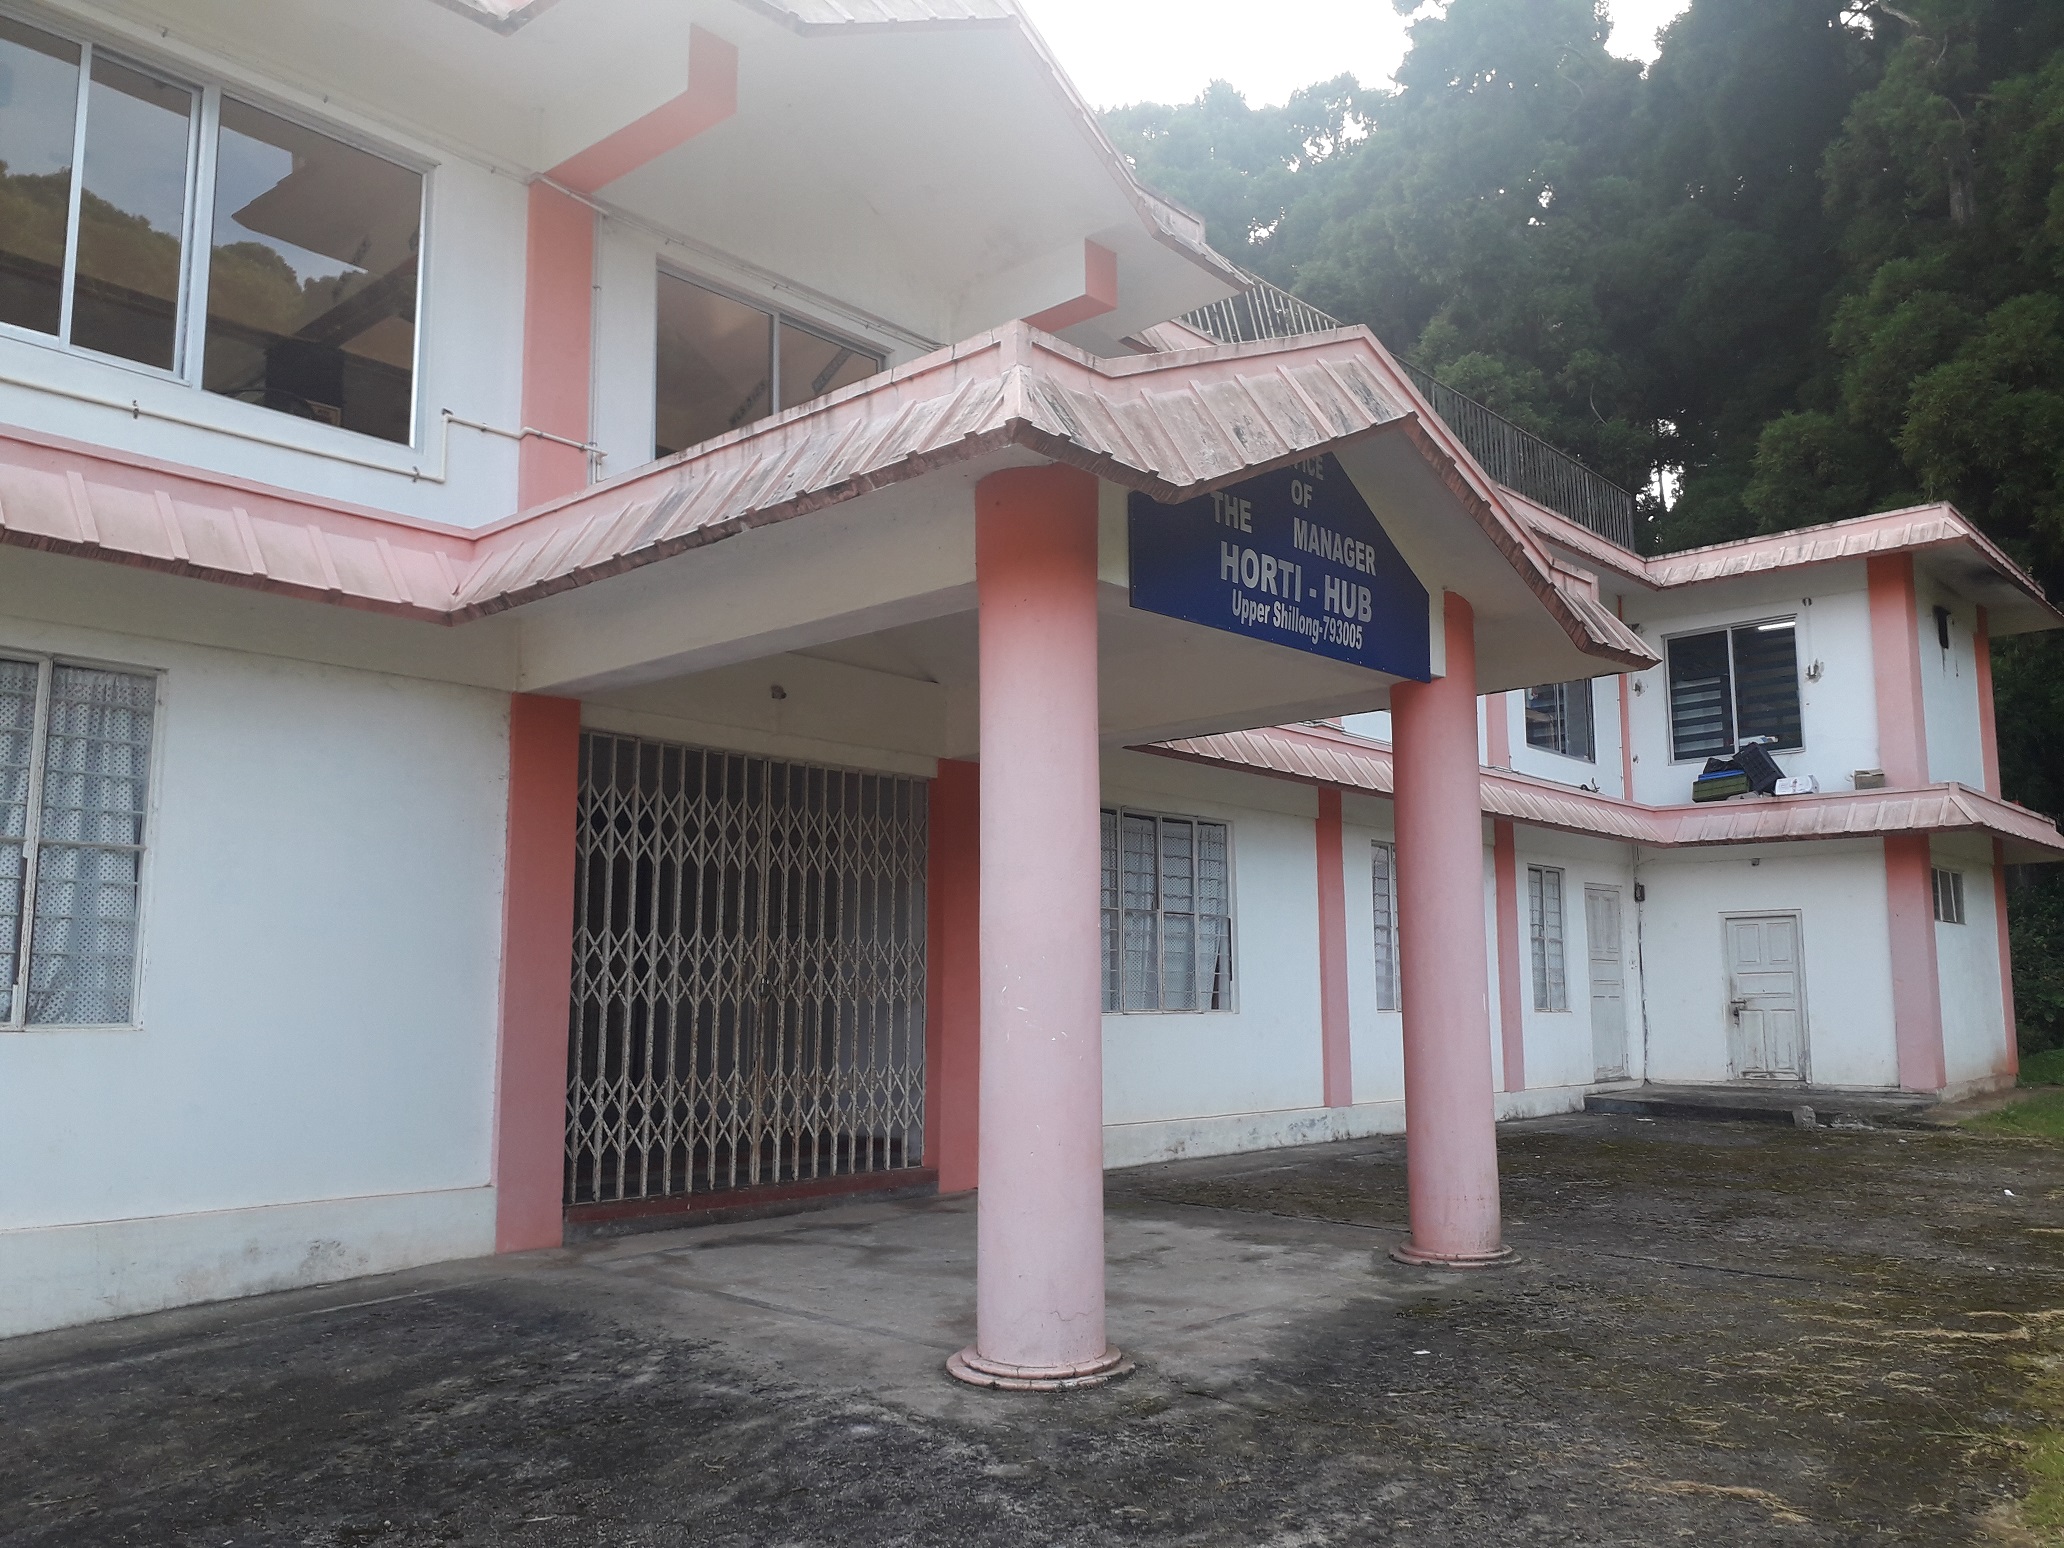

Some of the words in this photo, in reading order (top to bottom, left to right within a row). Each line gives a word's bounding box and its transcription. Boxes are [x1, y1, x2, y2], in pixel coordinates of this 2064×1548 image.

[1291, 479, 1313, 508] OF
[1211, 491, 1253, 533] THE
[1293, 517, 1377, 576] MANAGER
[1220, 540, 1302, 602] HORTI
[1323, 574, 1373, 623] HUB
[1232, 588, 1271, 627] Upper
[1272, 600, 1363, 650] Shillong-793005
